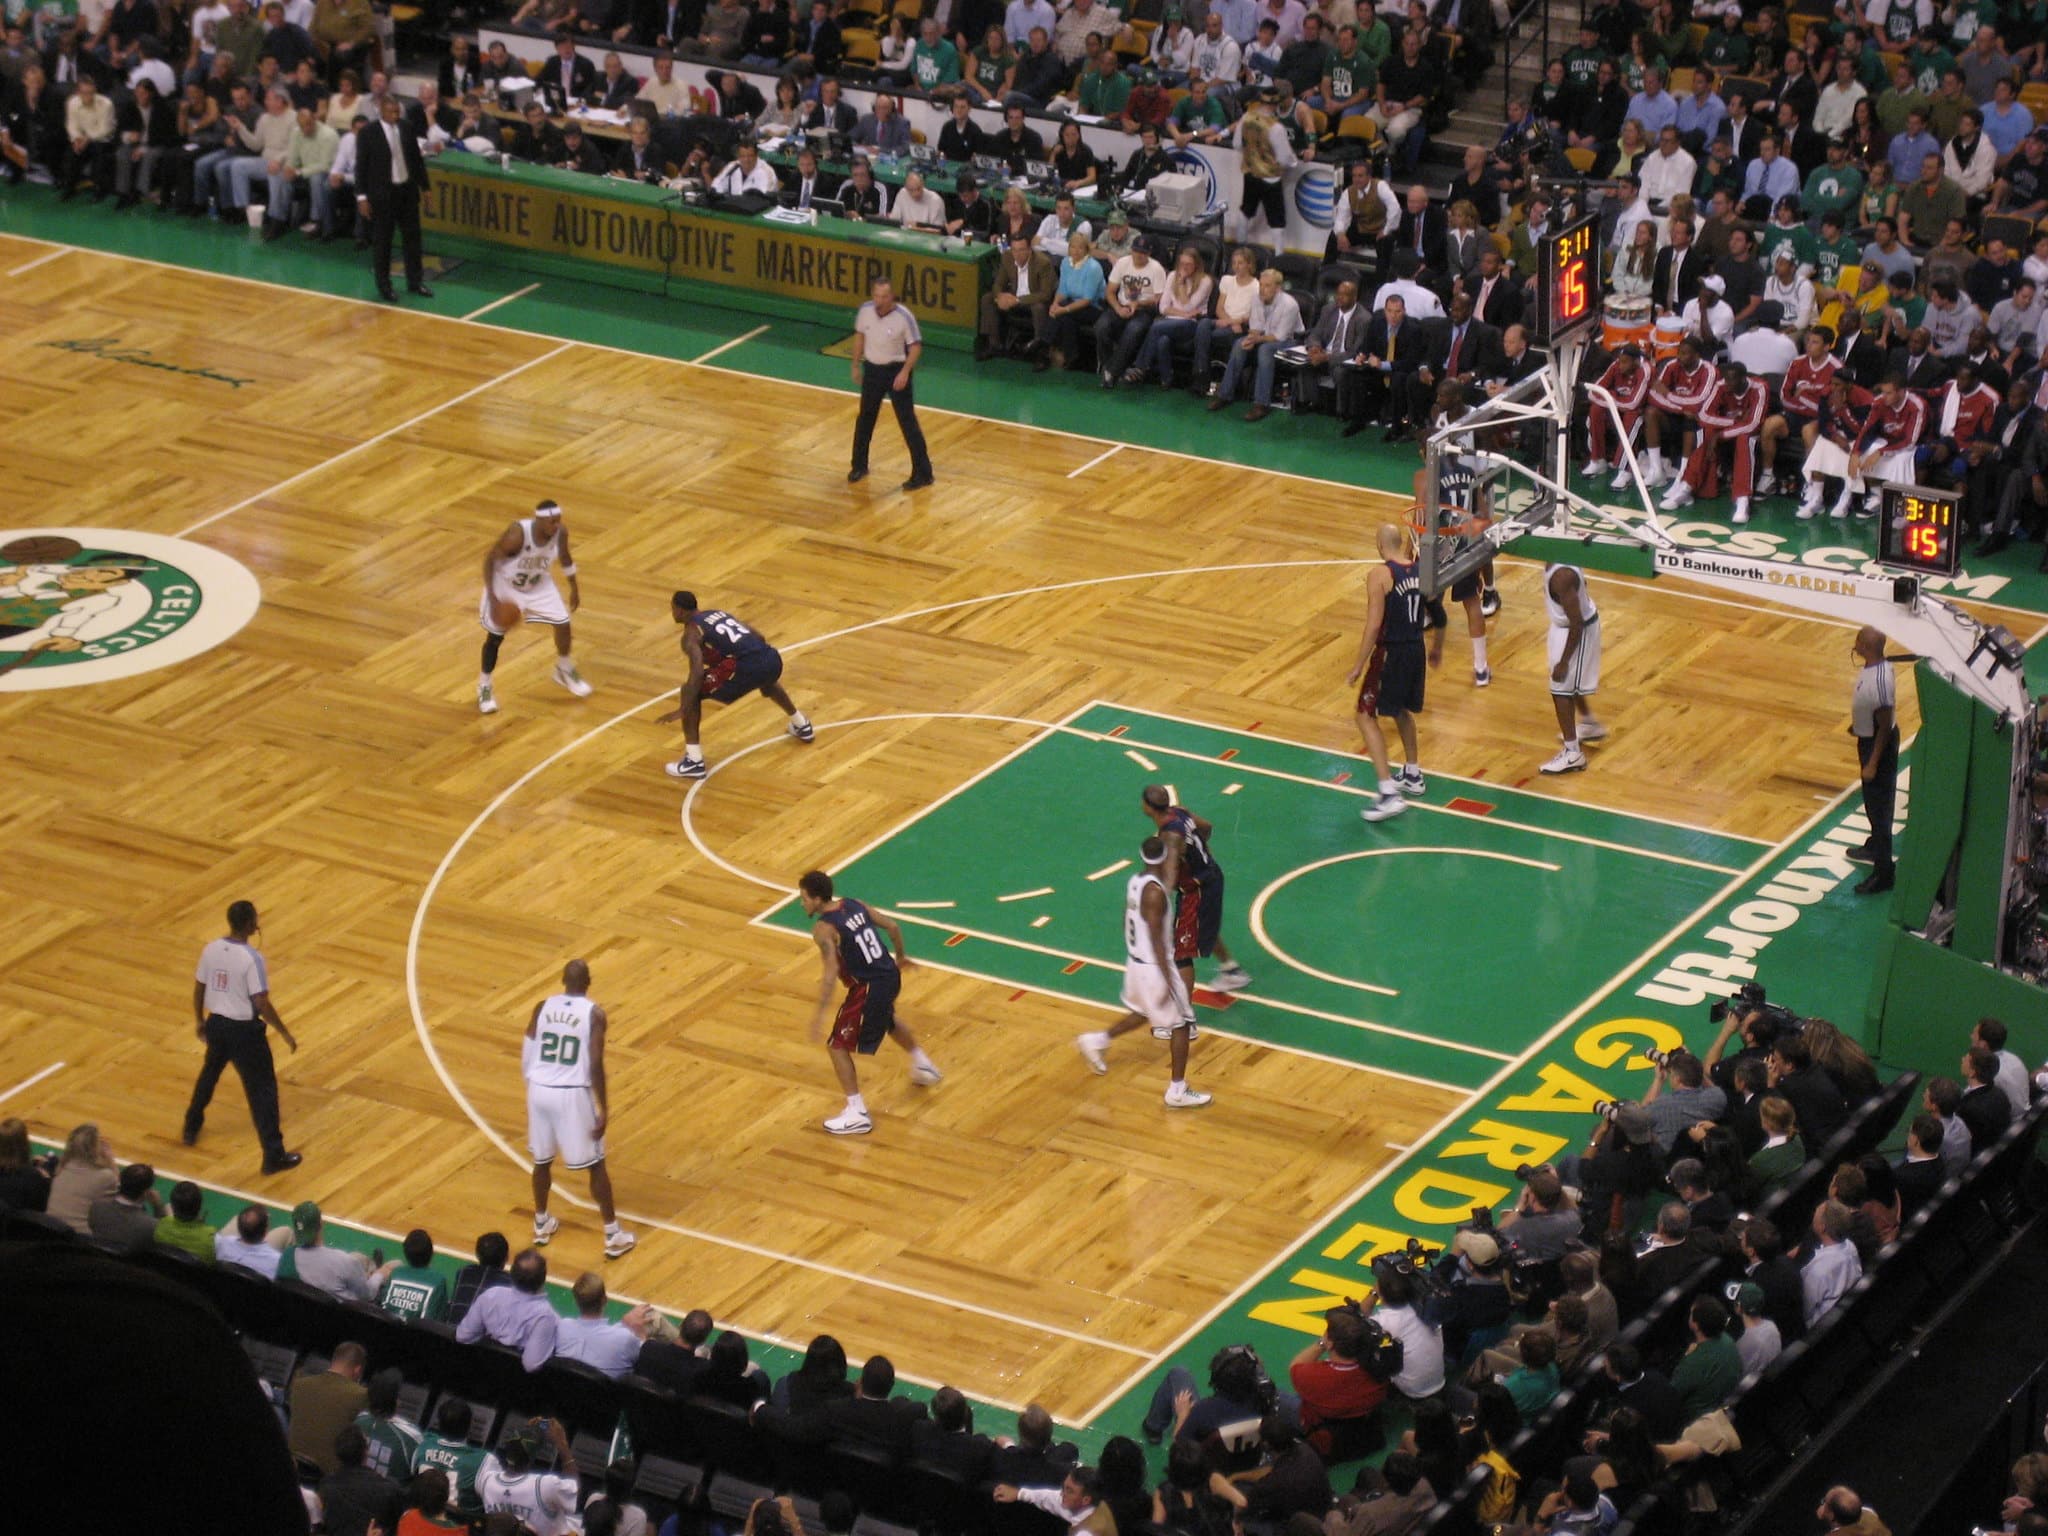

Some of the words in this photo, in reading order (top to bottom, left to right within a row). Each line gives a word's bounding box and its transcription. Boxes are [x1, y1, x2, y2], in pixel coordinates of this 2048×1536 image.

[421, 181, 531, 237] LTIMATE
[552, 203, 736, 272] AUTOMOTIVE
[1558, 224, 1589, 269] 3:11
[1563, 260, 1585, 318] 15
[1906, 497, 1949, 526] 3:11
[1911, 527, 1939, 557] 15
[1658, 553, 1679, 567] TD
[1682, 559, 1764, 581] Banknorth
[1767, 569, 1857, 597] GARDEN
[81, 584, 195, 658] CELTICS
[715, 618, 751, 644] 23
[854, 927, 883, 965] 13
[545, 1012, 581, 1029] ALLEN
[540, 1031, 581, 1067] 20
[1247, 1017, 1684, 1338] GARDEN
[389, 1297, 420, 1312] CELTICS
[393, 1287, 425, 1303] BOSTON
[424, 1448, 460, 1469] PIERCE
